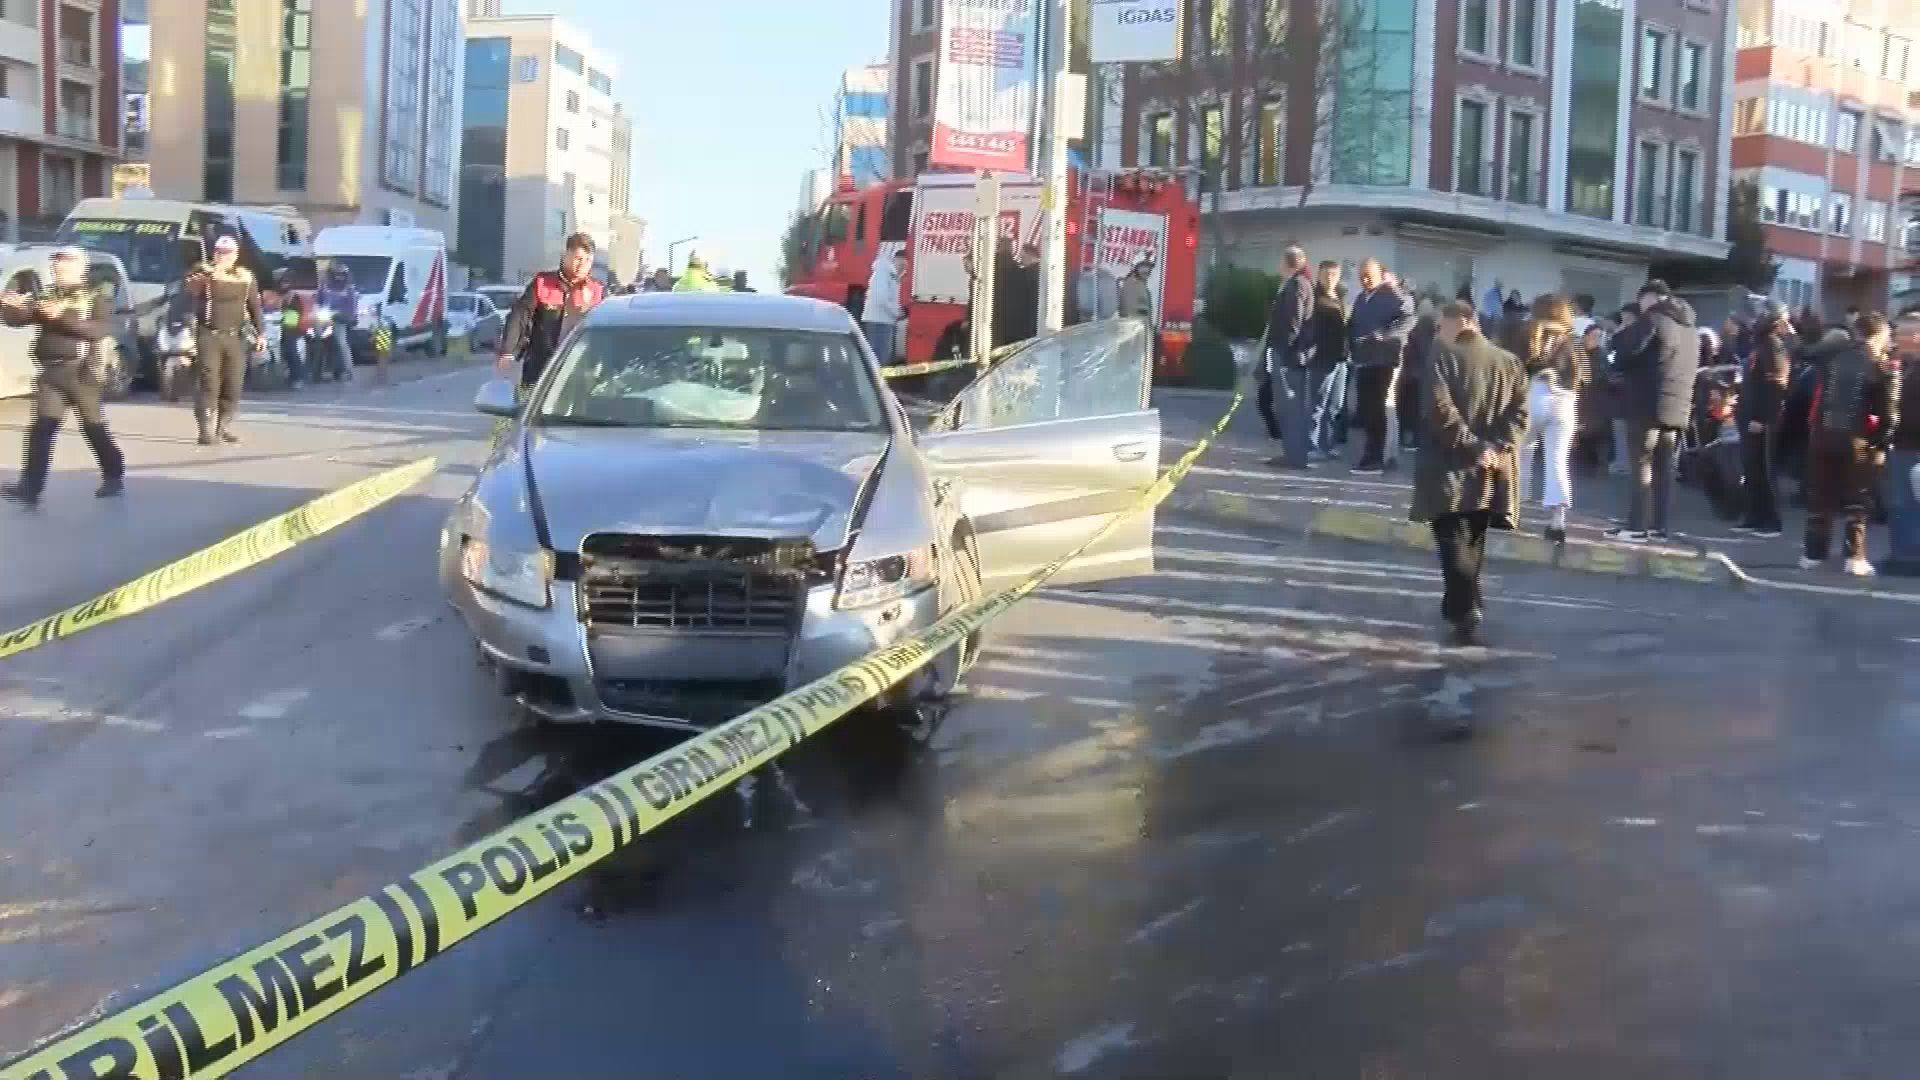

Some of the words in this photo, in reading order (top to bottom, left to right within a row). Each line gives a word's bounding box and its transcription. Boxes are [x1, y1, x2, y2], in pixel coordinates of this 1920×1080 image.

[920, 231, 972, 257] İTFAİYES
[922, 210, 975, 233] İSTANBU
[631, 716, 782, 811] GİRİLMEZ
[441, 811, 594, 921] POLİS
[24, 913, 387, 1080] RİLMEZ
